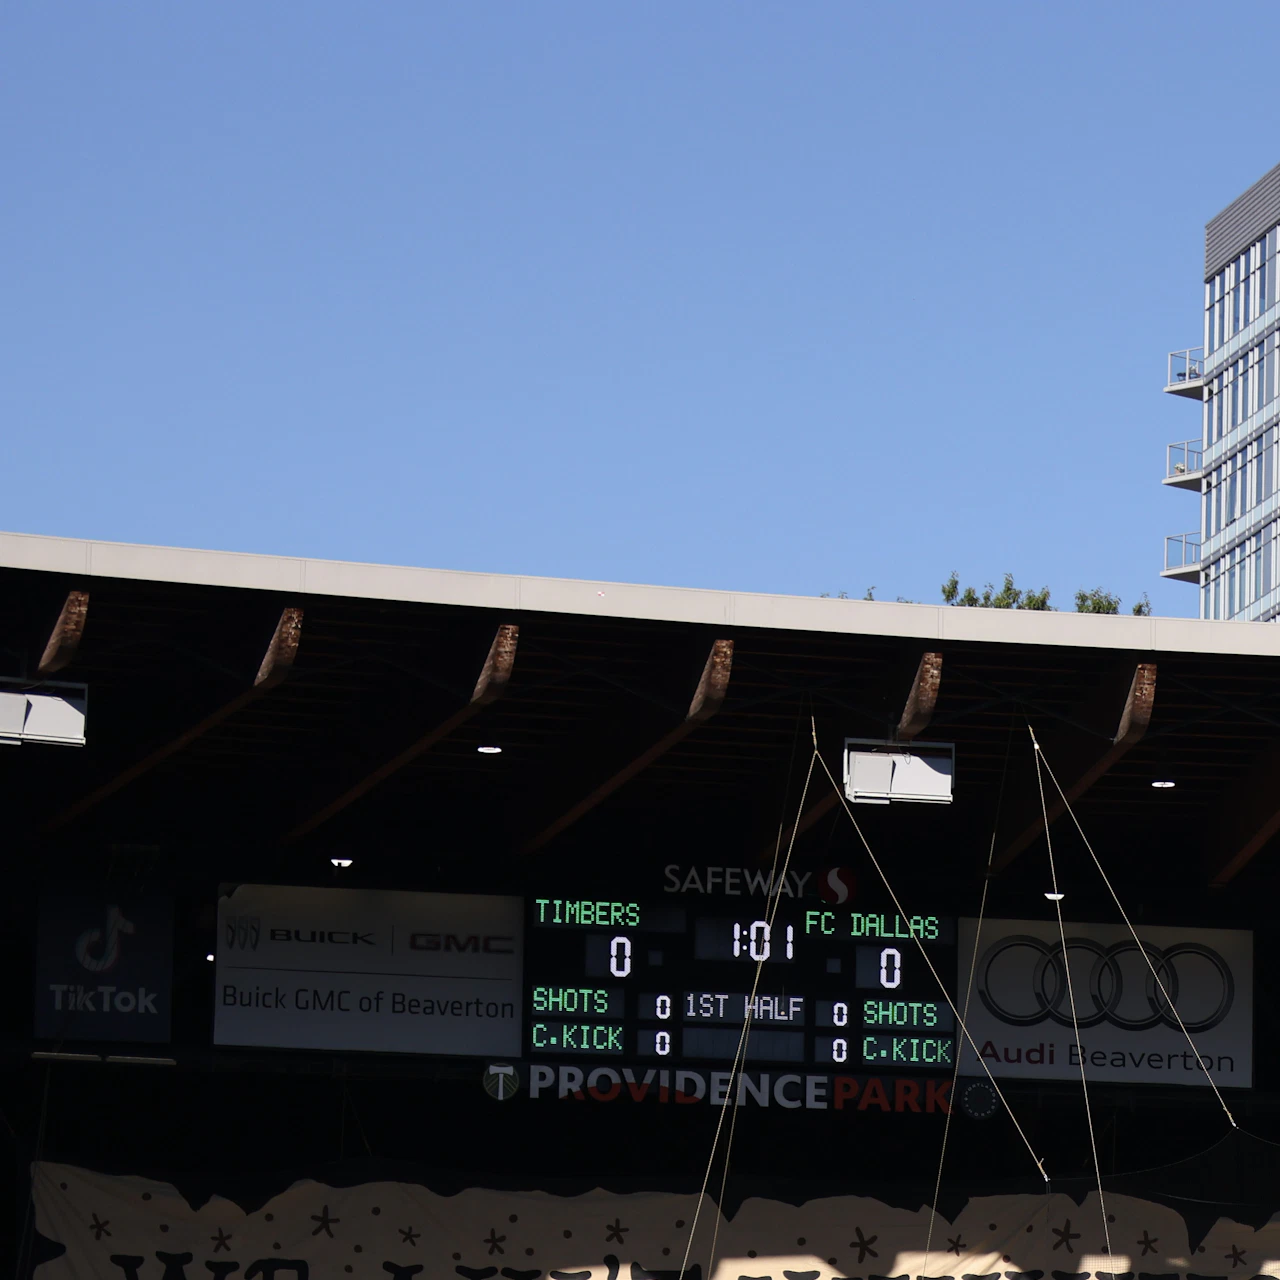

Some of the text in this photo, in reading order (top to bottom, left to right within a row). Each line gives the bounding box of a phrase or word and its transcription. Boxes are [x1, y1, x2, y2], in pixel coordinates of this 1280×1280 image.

[663, 865, 812, 899] SAFEWAY
[536, 899, 640, 927] TIMBERS
[805, 911, 939, 940] FC DALLAS
[269, 928, 376, 947] BUICK
[409, 933, 514, 954] GMC
[610, 936, 631, 978] 0
[880, 948, 901, 989] 0
[49, 983, 158, 1015] TikTok
[222, 985, 514, 1019] Buick GMC of Beaverton
[533, 988, 608, 1013] SHOTS
[656, 995, 671, 1019] 0
[687, 994, 804, 1021] 1ST HALF
[833, 1002, 848, 1027] 0
[863, 1001, 938, 1026] SHOTS
[532, 1024, 623, 1050] C.KICK
[655, 1032, 670, 1056] 0
[863, 1037, 952, 1063] C.KICK
[832, 1038, 848, 1063] 0
[976, 1040, 1235, 1073] Audi Beaverton
